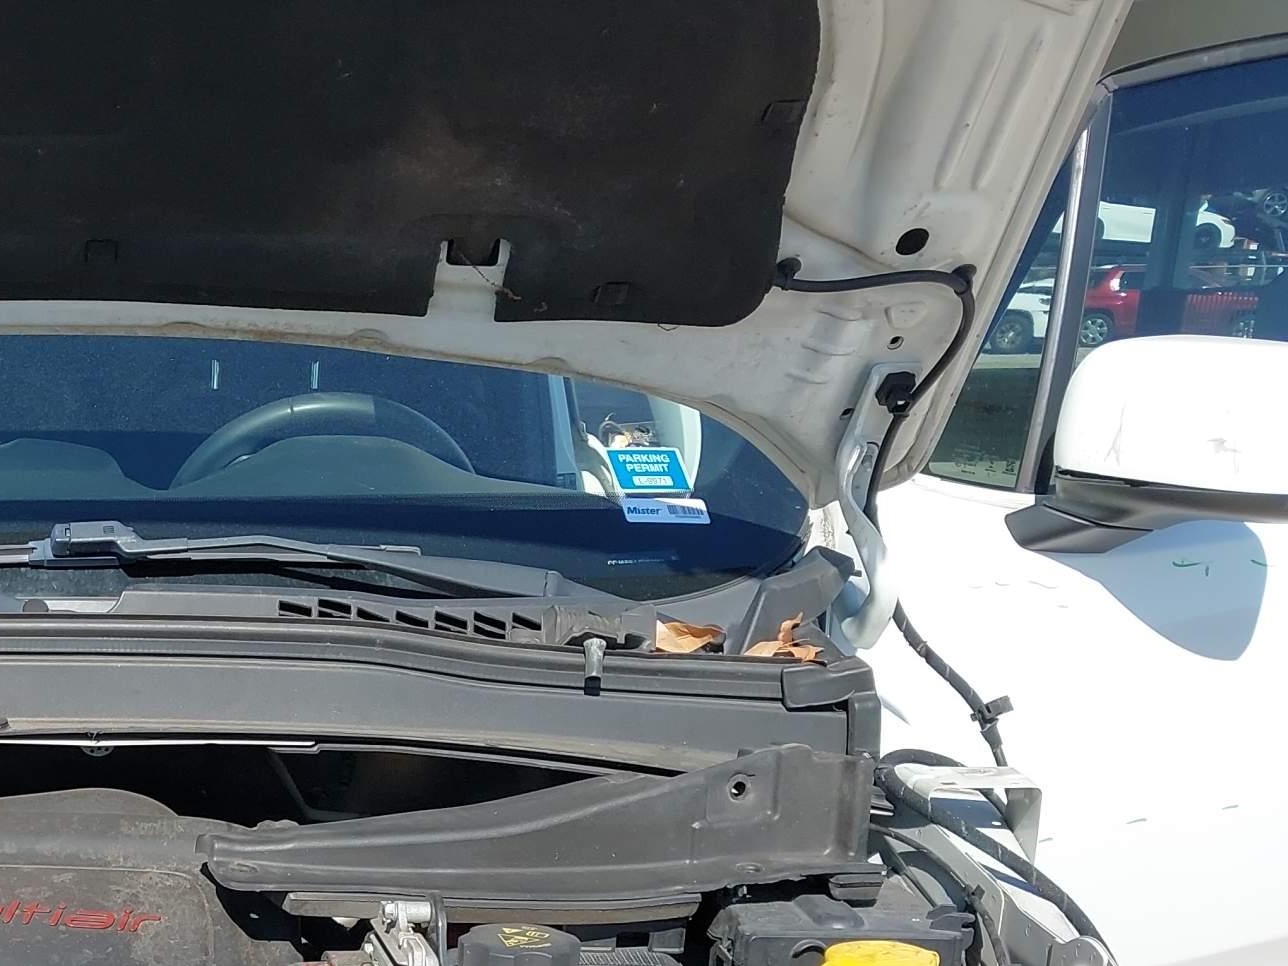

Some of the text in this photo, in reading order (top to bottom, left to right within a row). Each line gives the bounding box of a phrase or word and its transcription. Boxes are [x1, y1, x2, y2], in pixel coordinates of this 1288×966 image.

[618, 454, 670, 463] PARKING
[626, 463, 669, 472] PERMIT
[627, 506, 661, 515] Mister
